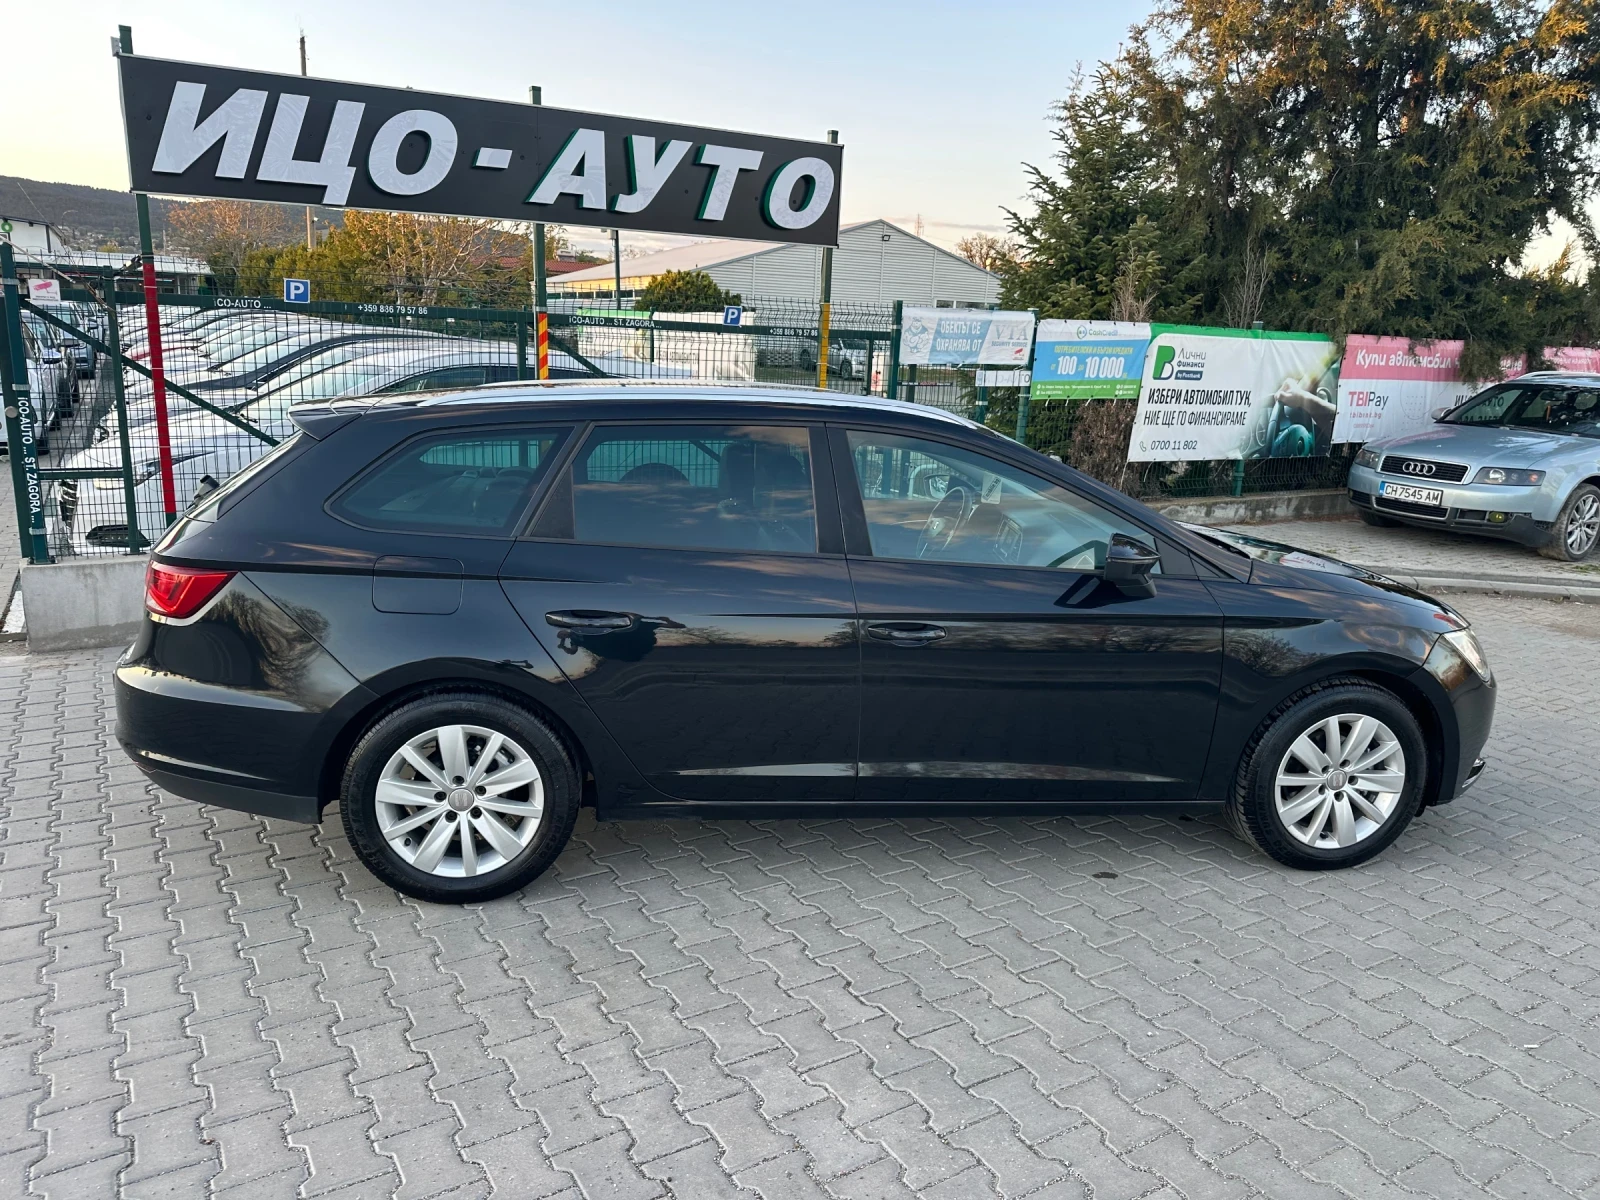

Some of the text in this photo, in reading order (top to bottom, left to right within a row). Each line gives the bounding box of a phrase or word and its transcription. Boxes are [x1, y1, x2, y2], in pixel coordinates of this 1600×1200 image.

[152, 81, 459, 206] ИЦО
[527, 128, 835, 229] АУТО
[290, 282, 304, 299] P
[396, 306, 405, 314] 79
[407, 306, 417, 314] 57
[418, 307, 428, 315] 86
[727, 309, 738, 323] P
[625, 319, 655, 328] ZAGORA
[940, 321, 981, 335] ОБЕКТЪТ СЕ
[994, 324, 1029, 340] VTA
[936, 338, 982, 352] ОХРАНЯВА ОТ
[1178, 348, 1207, 360] Лични
[1356, 349, 1387, 369] Купи
[1057, 355, 1077, 375] 100
[1084, 356, 1099, 378] 10
[1099, 356, 1125, 379] 000
[1148, 388, 1182, 405] ИЗБЕРИ
[1182, 389, 1234, 406] АВТОМОБИЛ
[1348, 391, 1389, 410] TBIPay
[1143, 410, 1247, 428] НИЕ ЩЕ ГО ФИНАНСИРАМЕ
[1150, 440, 1198, 450] 0700 11 802
[24, 457, 36, 471] ST.
[26, 473, 41, 513] ZAGORA
[1385, 485, 1440, 503] CH 7545 AM
